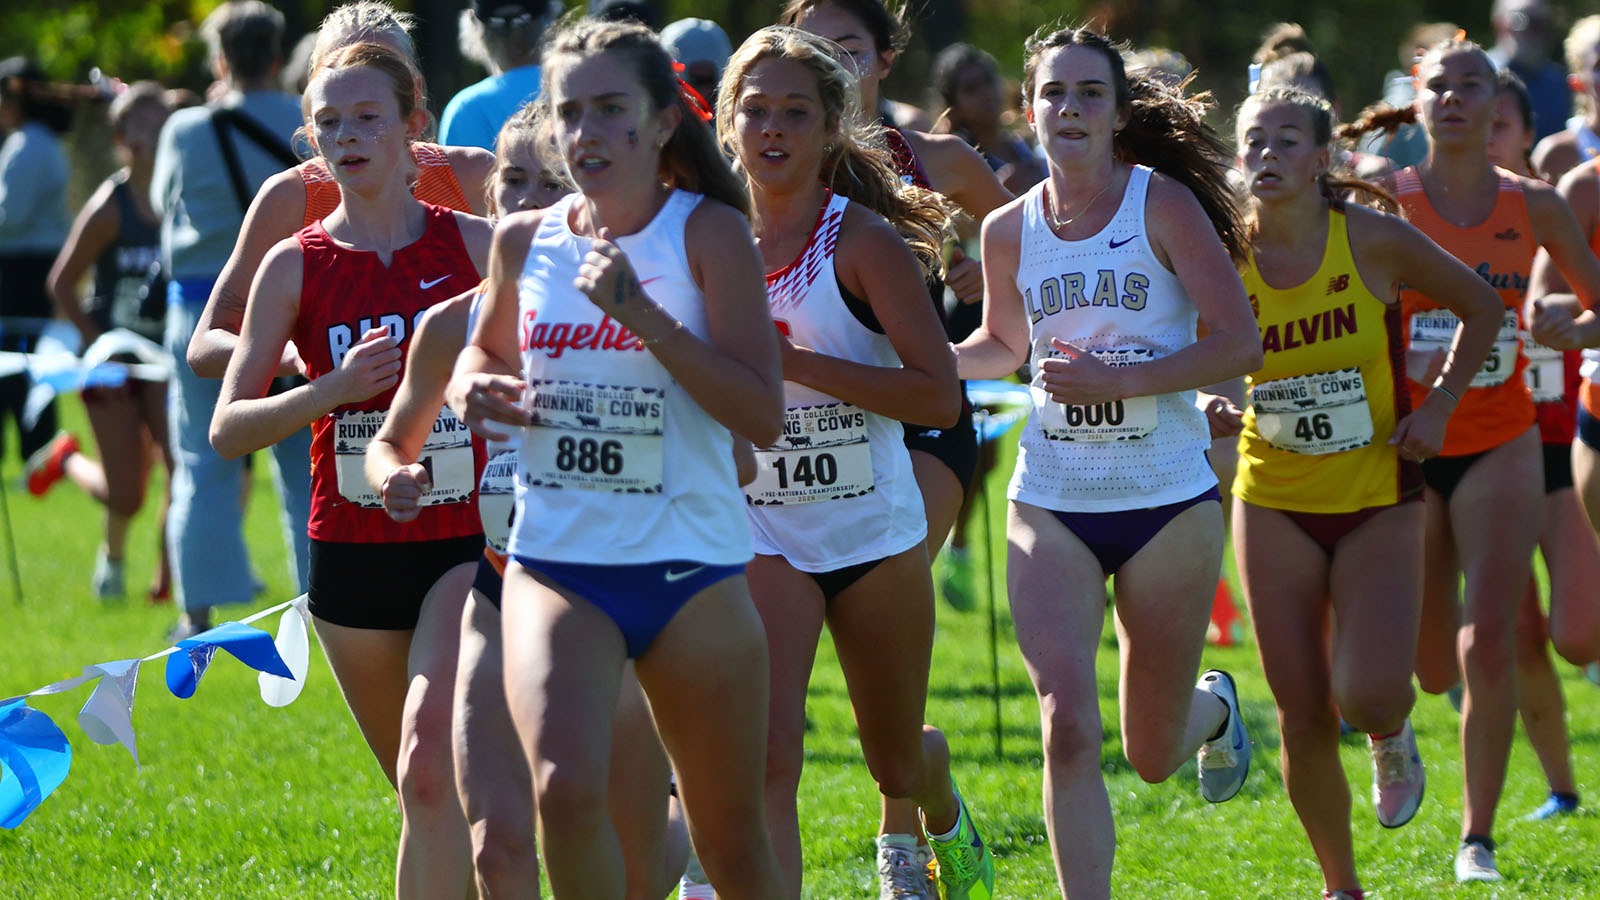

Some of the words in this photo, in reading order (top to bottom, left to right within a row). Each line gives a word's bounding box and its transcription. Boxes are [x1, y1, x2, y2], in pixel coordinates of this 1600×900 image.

[1025, 269, 1150, 325] LORAS
[519, 309, 644, 358] Sagehe
[1259, 303, 1358, 354] ALVIN
[1254, 386, 1308, 401] RUNNING
[1321, 377, 1361, 395] COWS
[534, 392, 594, 414] RUNNING
[610, 400, 660, 418] COWS
[803, 408, 839, 419] COLLEGE
[1066, 399, 1125, 427] 600
[338, 422, 382, 440] RUNN
[431, 416, 468, 435] OWS
[817, 412, 864, 432] COWS
[1295, 412, 1334, 442] 46
[556, 434, 624, 475] 886
[772, 452, 838, 489] 140
[808, 484, 855, 495] CHAMPIONSHIP
